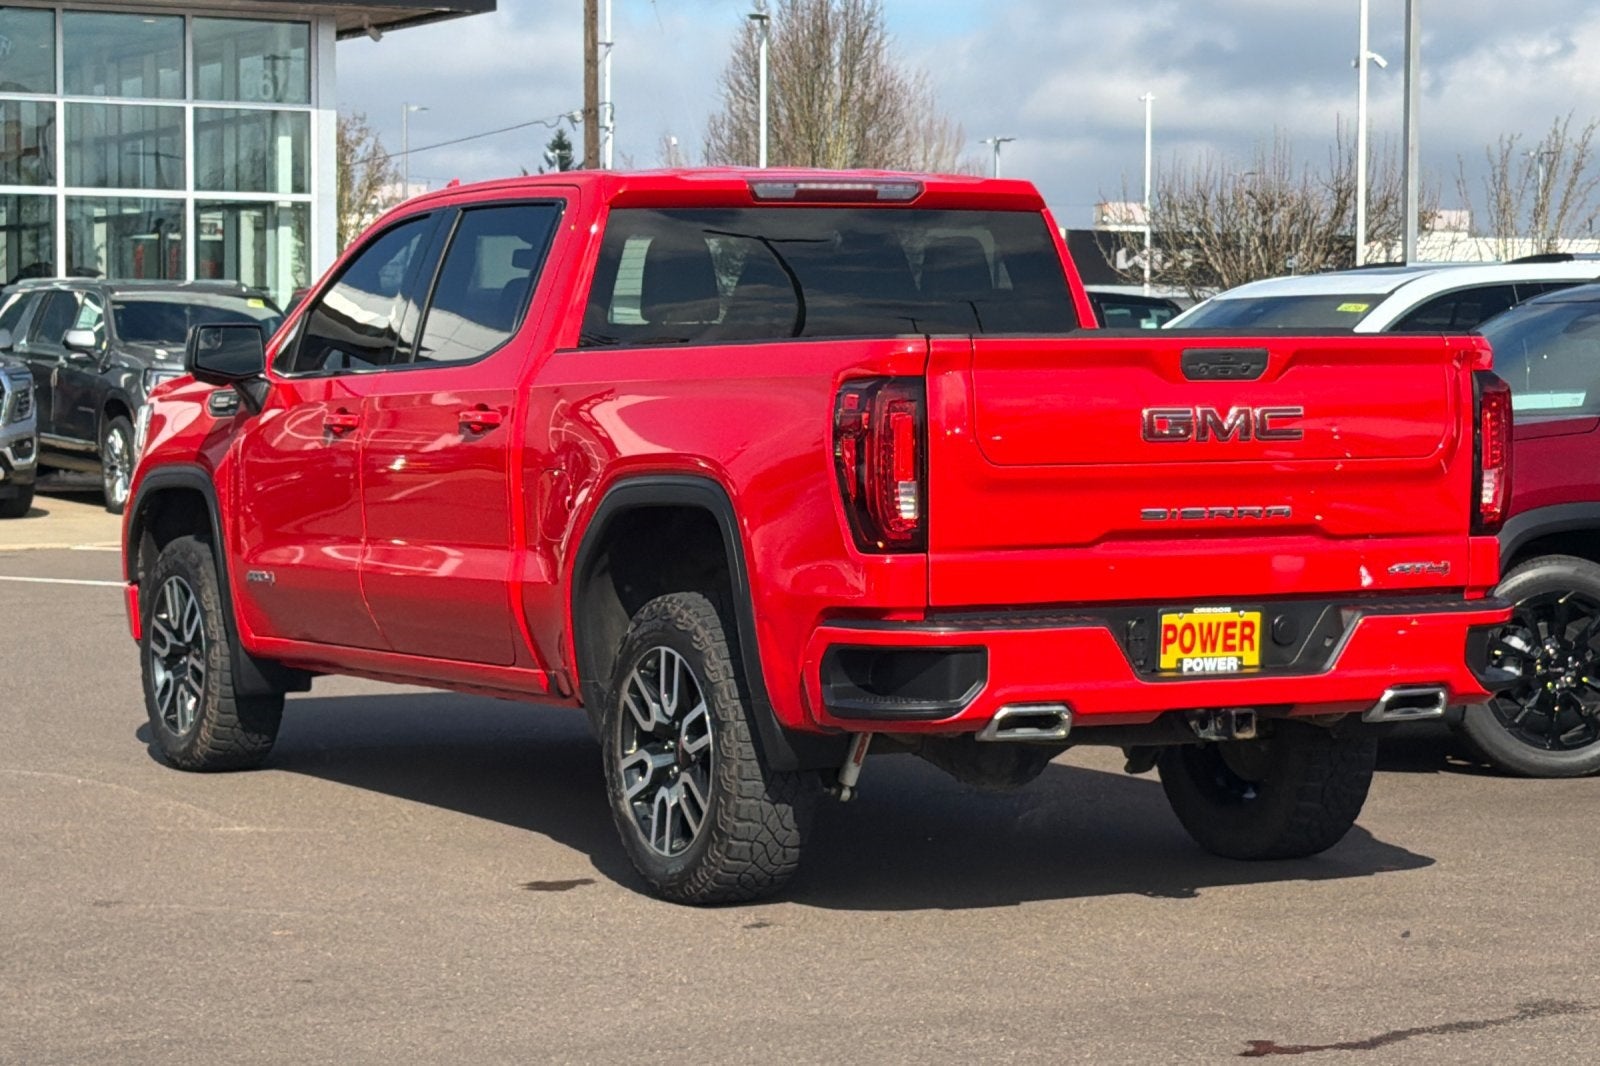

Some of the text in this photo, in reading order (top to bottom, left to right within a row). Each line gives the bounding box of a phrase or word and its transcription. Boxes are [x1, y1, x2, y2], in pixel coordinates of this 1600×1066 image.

[1142, 406, 1304, 442] GMC
[1140, 505, 1292, 520] SIERRA
[1161, 620, 1256, 655] POWER
[1182, 656, 1238, 672] POWER
